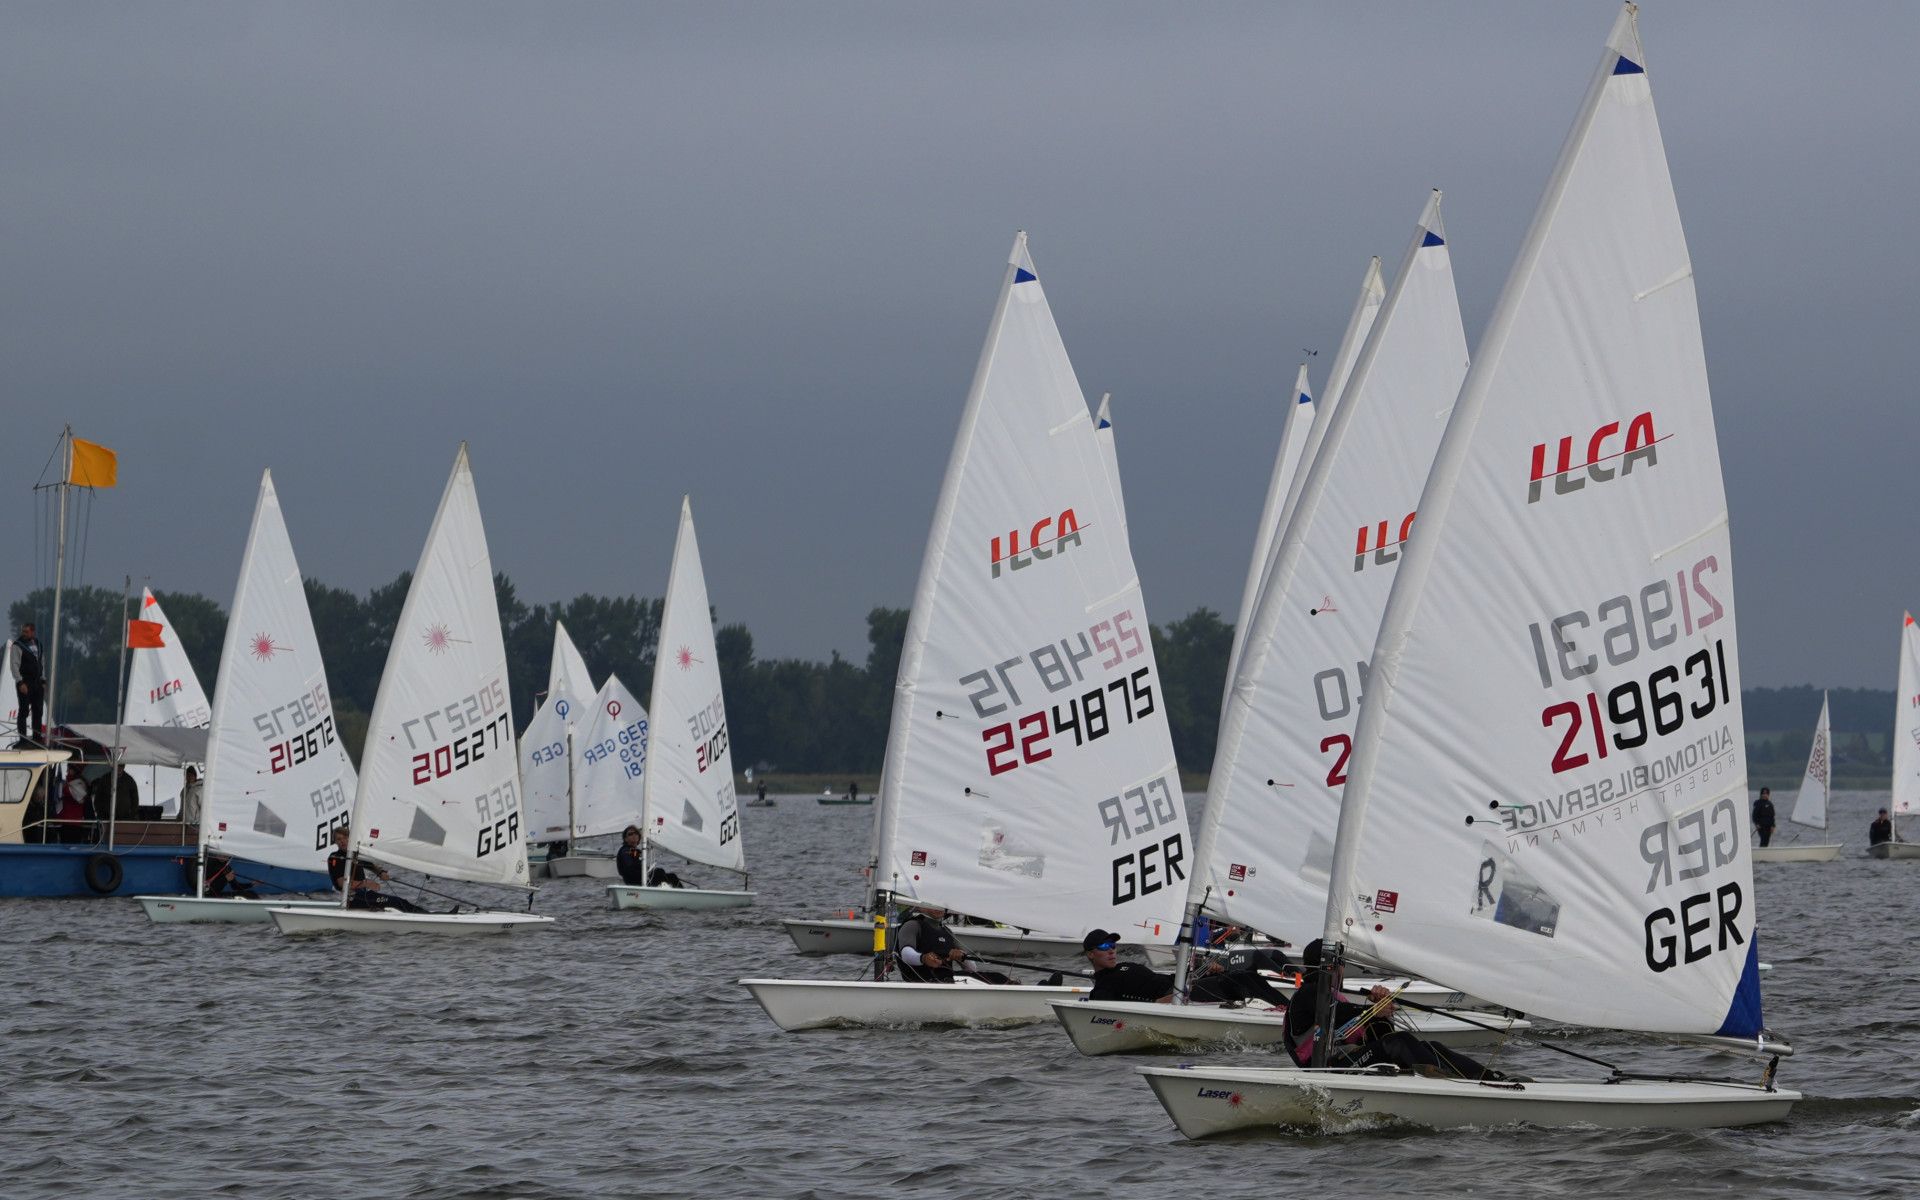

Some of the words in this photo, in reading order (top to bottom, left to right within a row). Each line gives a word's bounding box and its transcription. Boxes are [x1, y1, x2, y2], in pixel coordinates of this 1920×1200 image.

[1528, 411, 1660, 504] ILCA
[991, 508, 1083, 580] ILCA
[149, 679, 182, 704] ILCA
[1542, 639, 1730, 774] 219631
[269, 715, 334, 774] 213672
[412, 712, 510, 786] 205277
[619, 720, 649, 745] GER
[982, 667, 1154, 776] 224875
[477, 811, 519, 858] GER
[720, 810, 738, 847] GER
[1112, 832, 1187, 906] GER
[1478, 857, 1497, 911] R
[1644, 881, 1744, 973] GER
[1230, 954, 1246, 965] Gill
[1090, 1015, 1117, 1025] Laser
[1197, 1087, 1232, 1099] Laser
